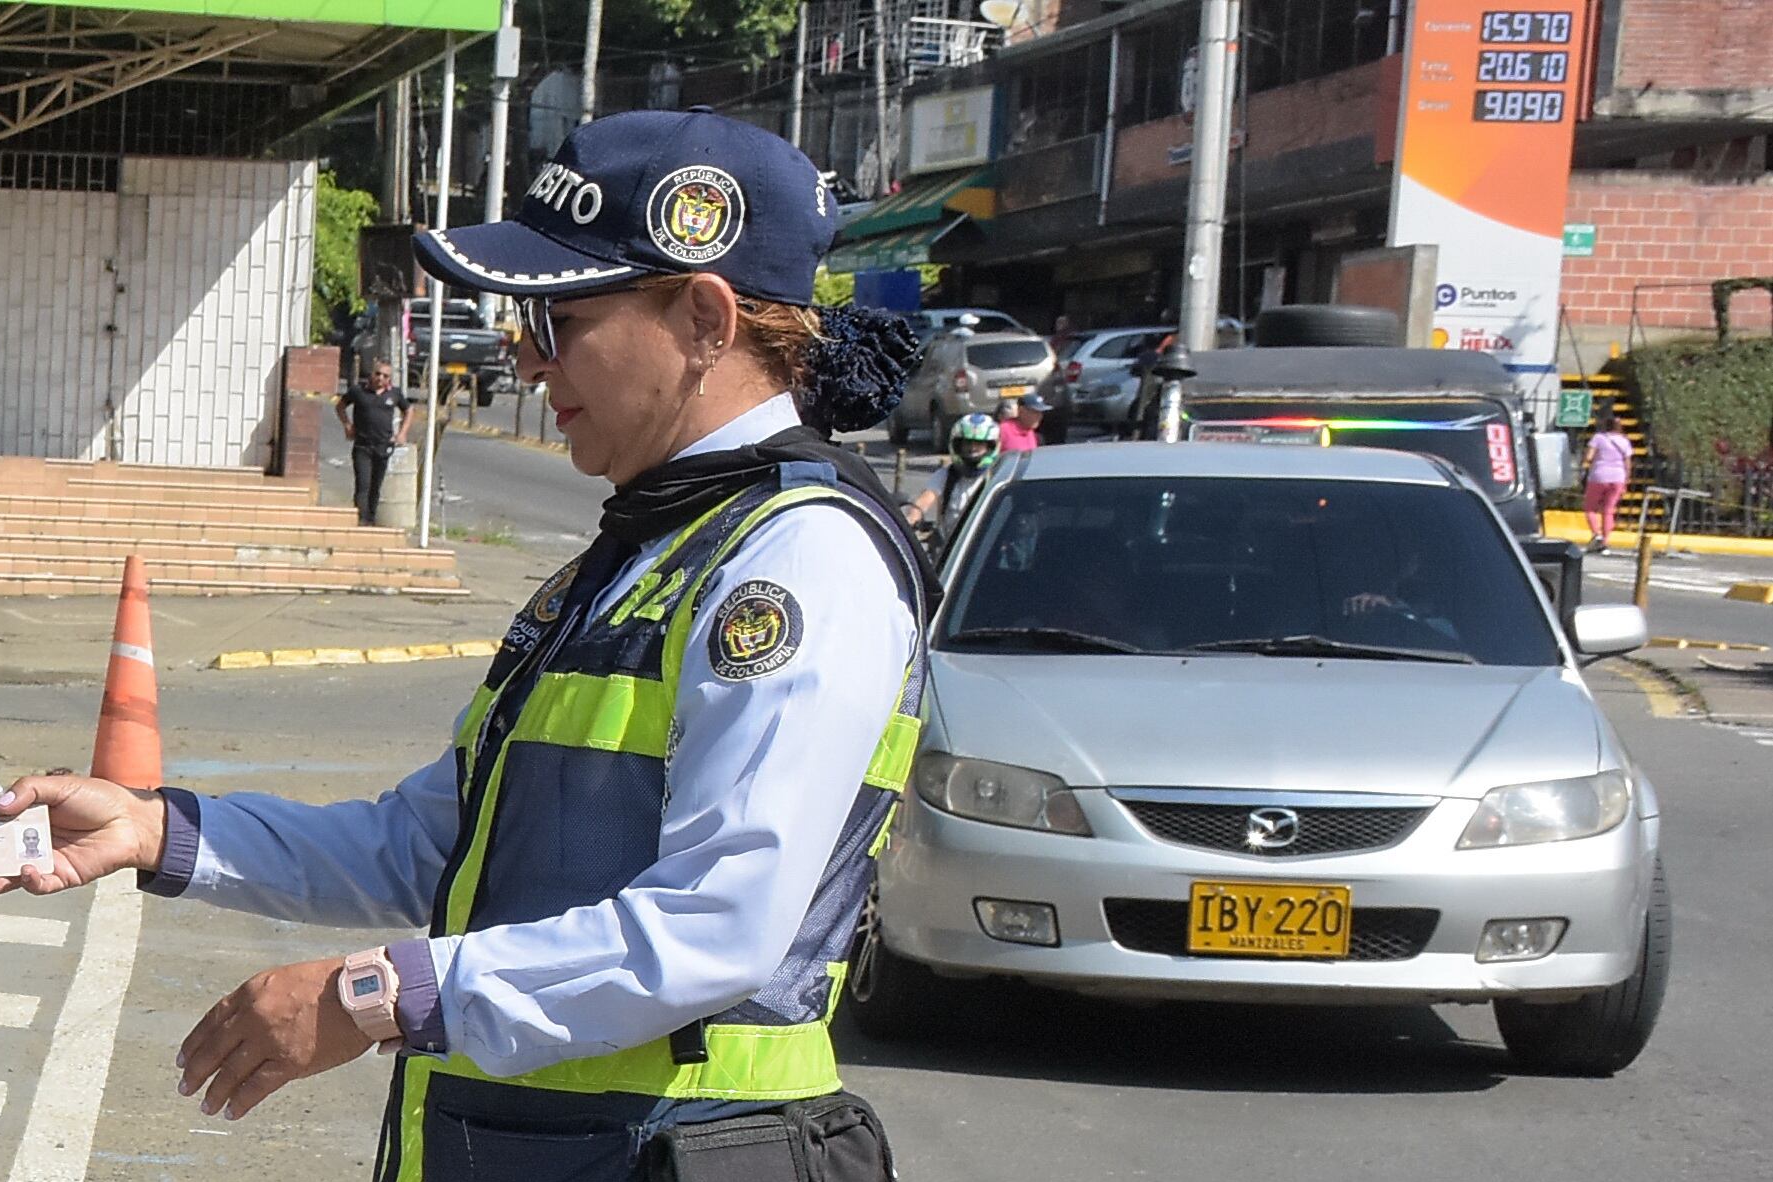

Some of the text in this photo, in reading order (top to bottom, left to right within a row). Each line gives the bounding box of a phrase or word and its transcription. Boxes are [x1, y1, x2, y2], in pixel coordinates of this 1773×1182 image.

[1461, 286, 1517, 301] Puntos
[715, 644, 796, 678] DE COLOMBIA
[1230, 936, 1307, 951] MANIZALES
